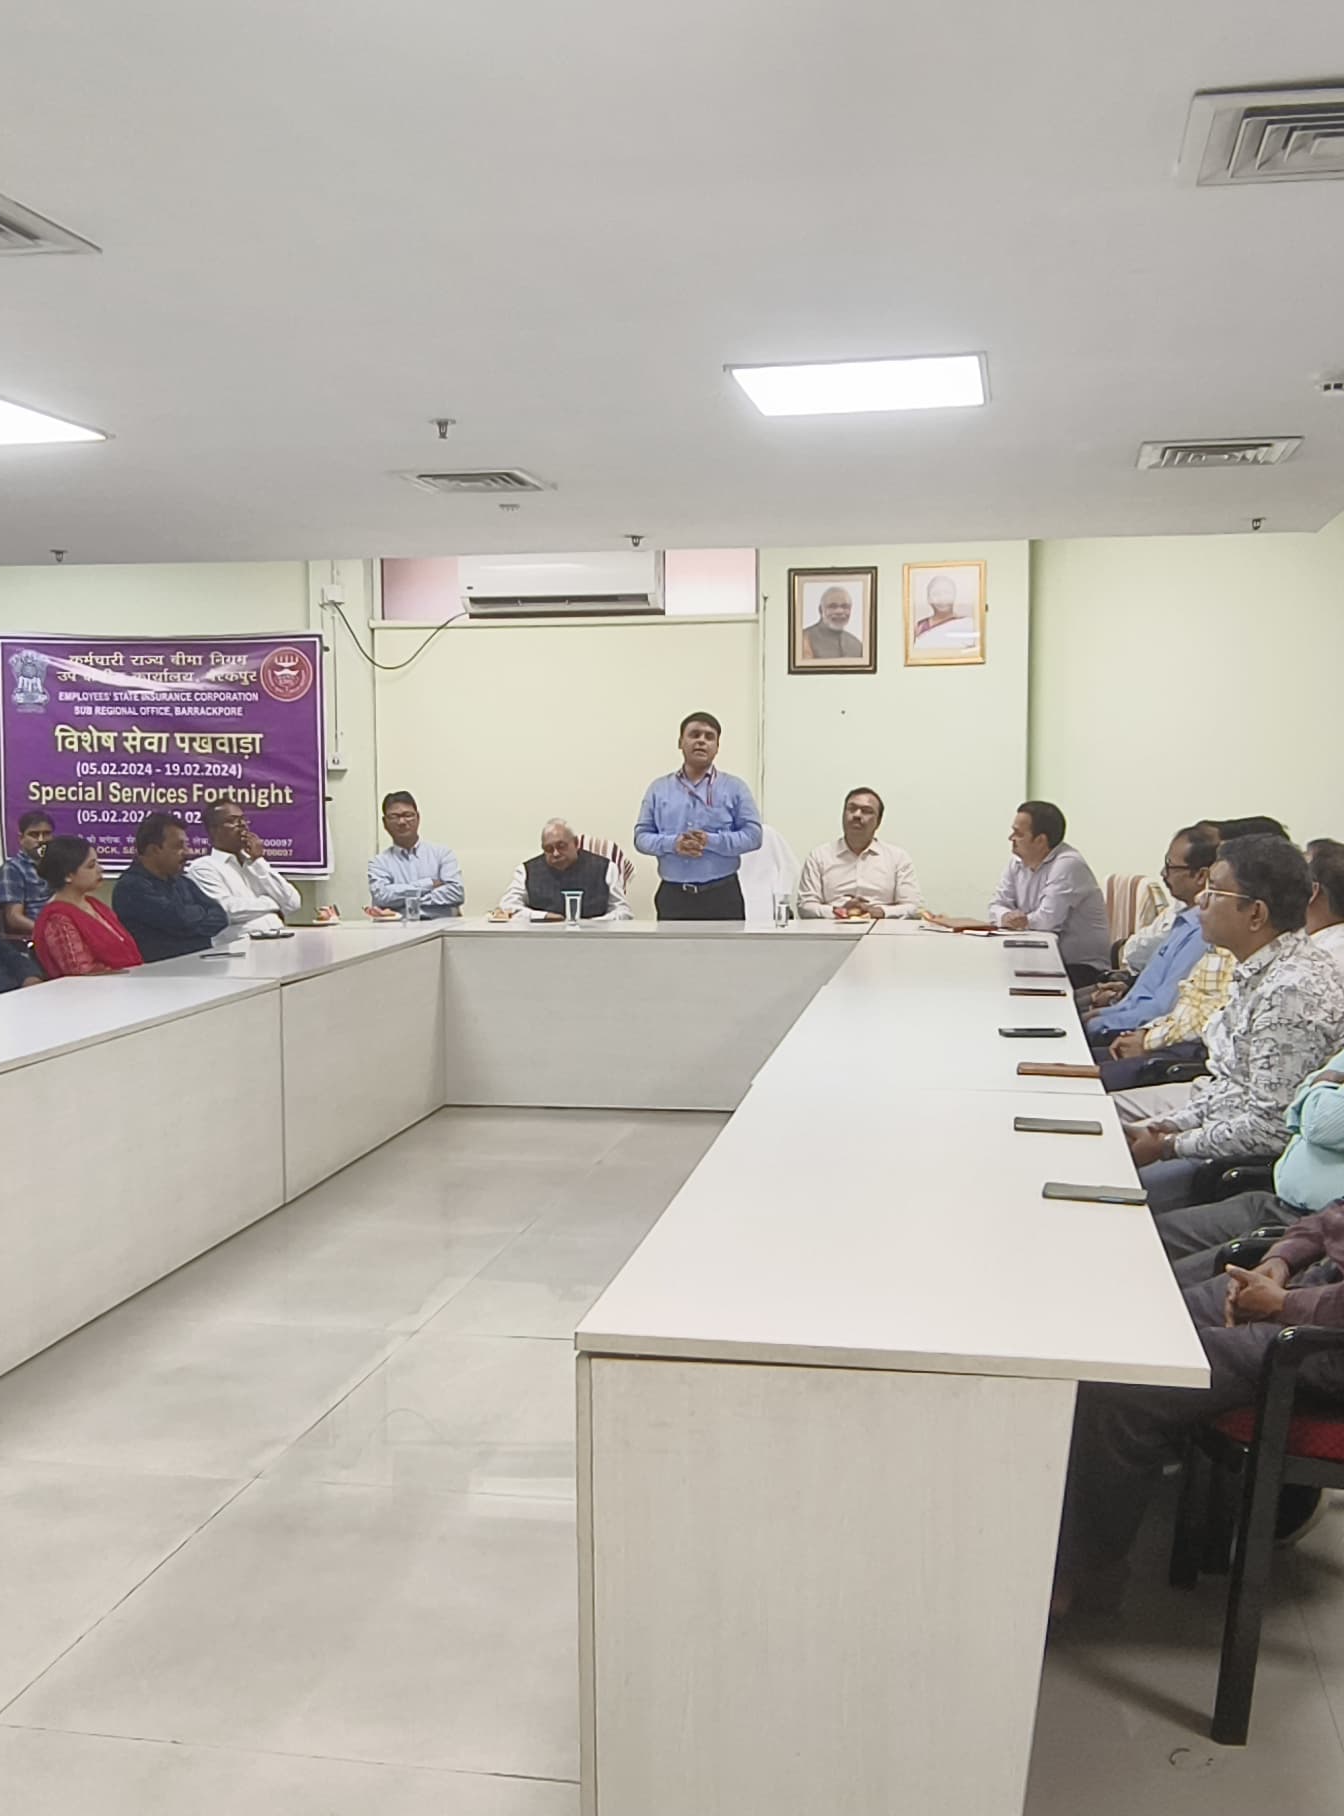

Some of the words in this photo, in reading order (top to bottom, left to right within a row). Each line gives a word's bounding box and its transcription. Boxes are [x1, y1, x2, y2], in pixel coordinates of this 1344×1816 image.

[130, 655, 165, 666] राज्य
[170, 651, 204, 666] बीमा
[113, 691, 140, 702] STATE
[141, 691, 193, 702] INSURANCE
[194, 691, 259, 702] CORPORATION
[74, 705, 93, 716] SUB
[94, 705, 138, 716] REGIONAL
[174, 706, 244, 716] BARRACKPORE
[54, 724, 118, 753] विशेष
[122, 725, 170, 754] सेवा
[174, 732, 264, 760] पखवाड़ा
[76, 761, 153, 778] (05.02.2024
[164, 762, 243, 779] 19.02.2024)
[28, 781, 103, 805] Special
[108, 782, 189, 804] Services
[192, 783, 294, 808] Fortnight
[76, 808, 153, 825] (05.02.202
